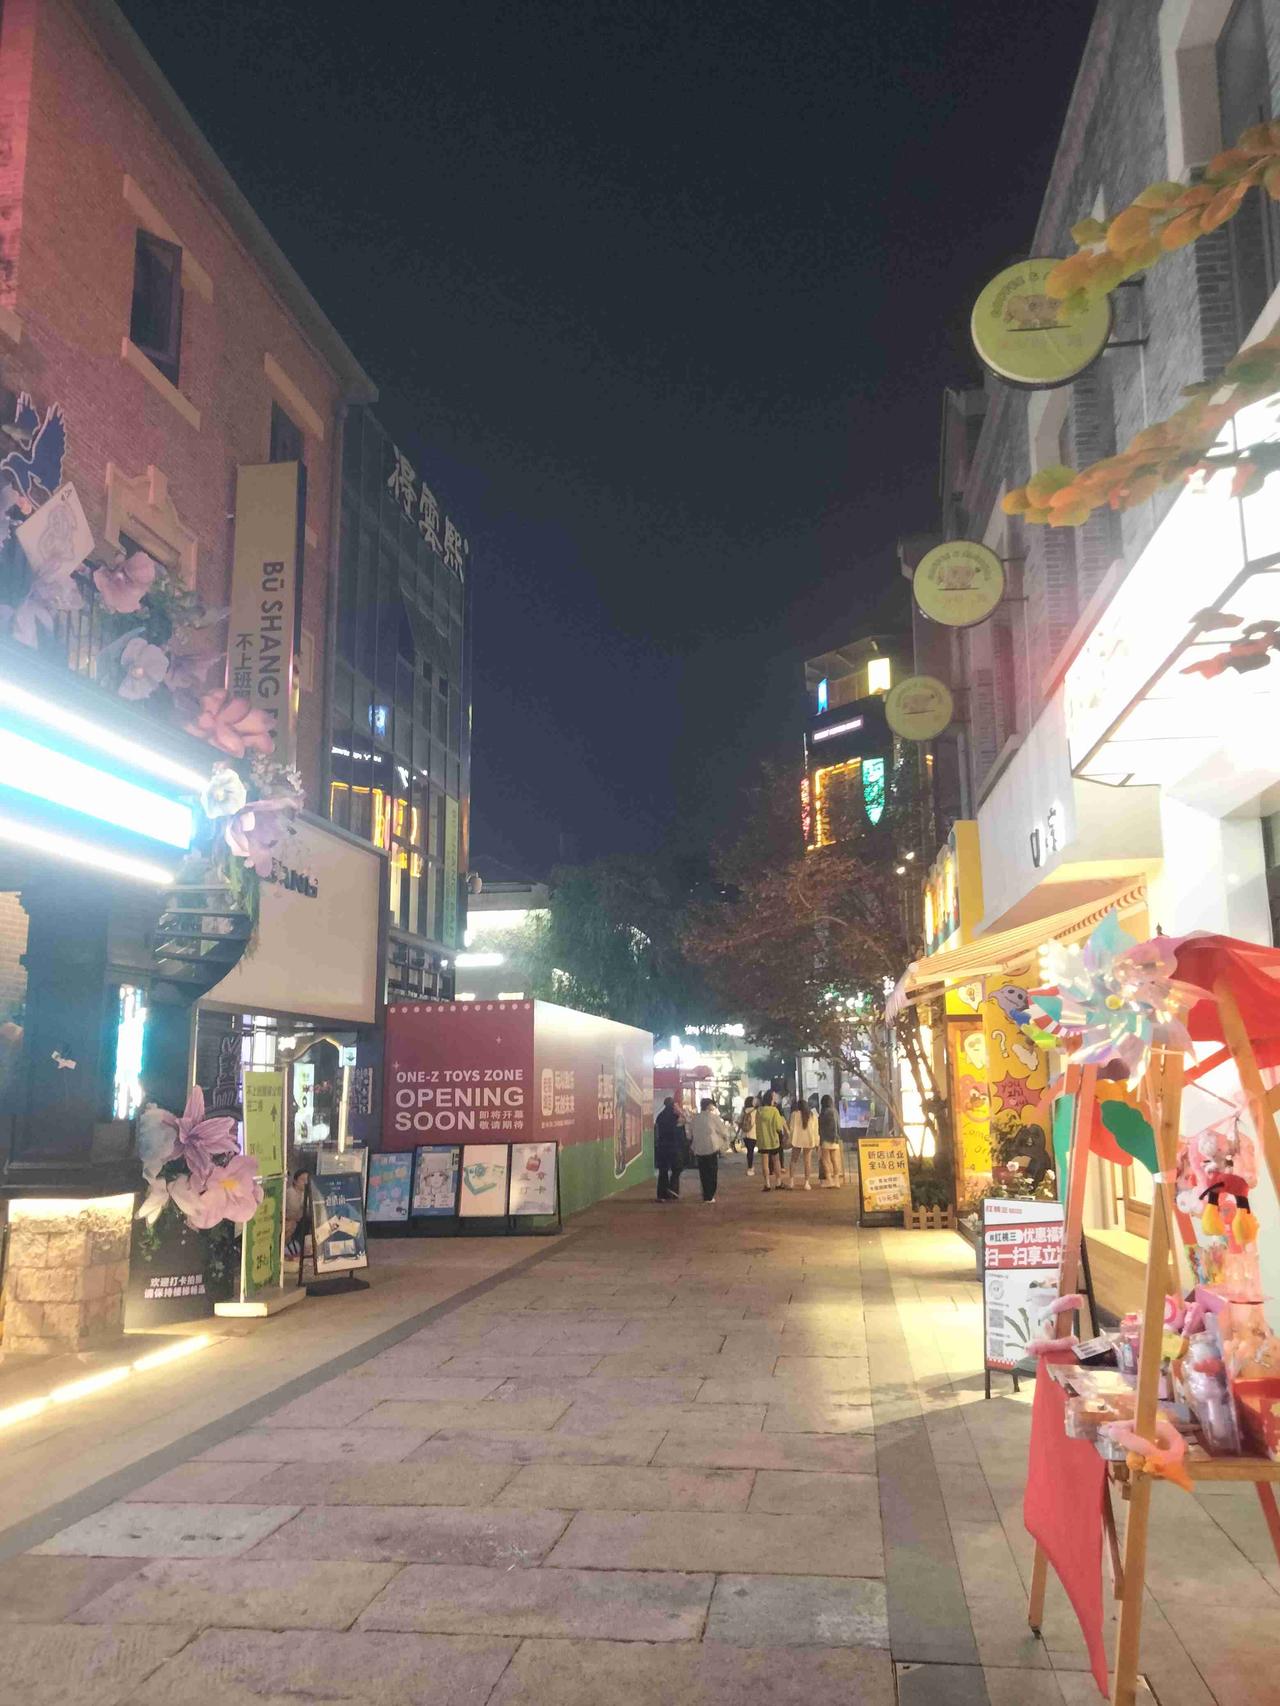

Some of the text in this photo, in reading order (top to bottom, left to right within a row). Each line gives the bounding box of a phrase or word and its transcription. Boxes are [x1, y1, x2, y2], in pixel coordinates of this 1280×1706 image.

[257, 600, 284, 698] SHANG
[396, 1069, 524, 1083] ONE-Z TOYS ZONE
[395, 1086, 524, 1108] OPENING
[395, 1111, 475, 1131] SOON
[479, 1110, 524, 1120] 即将开幕
[479, 1120, 524, 1130] 敬请期待
